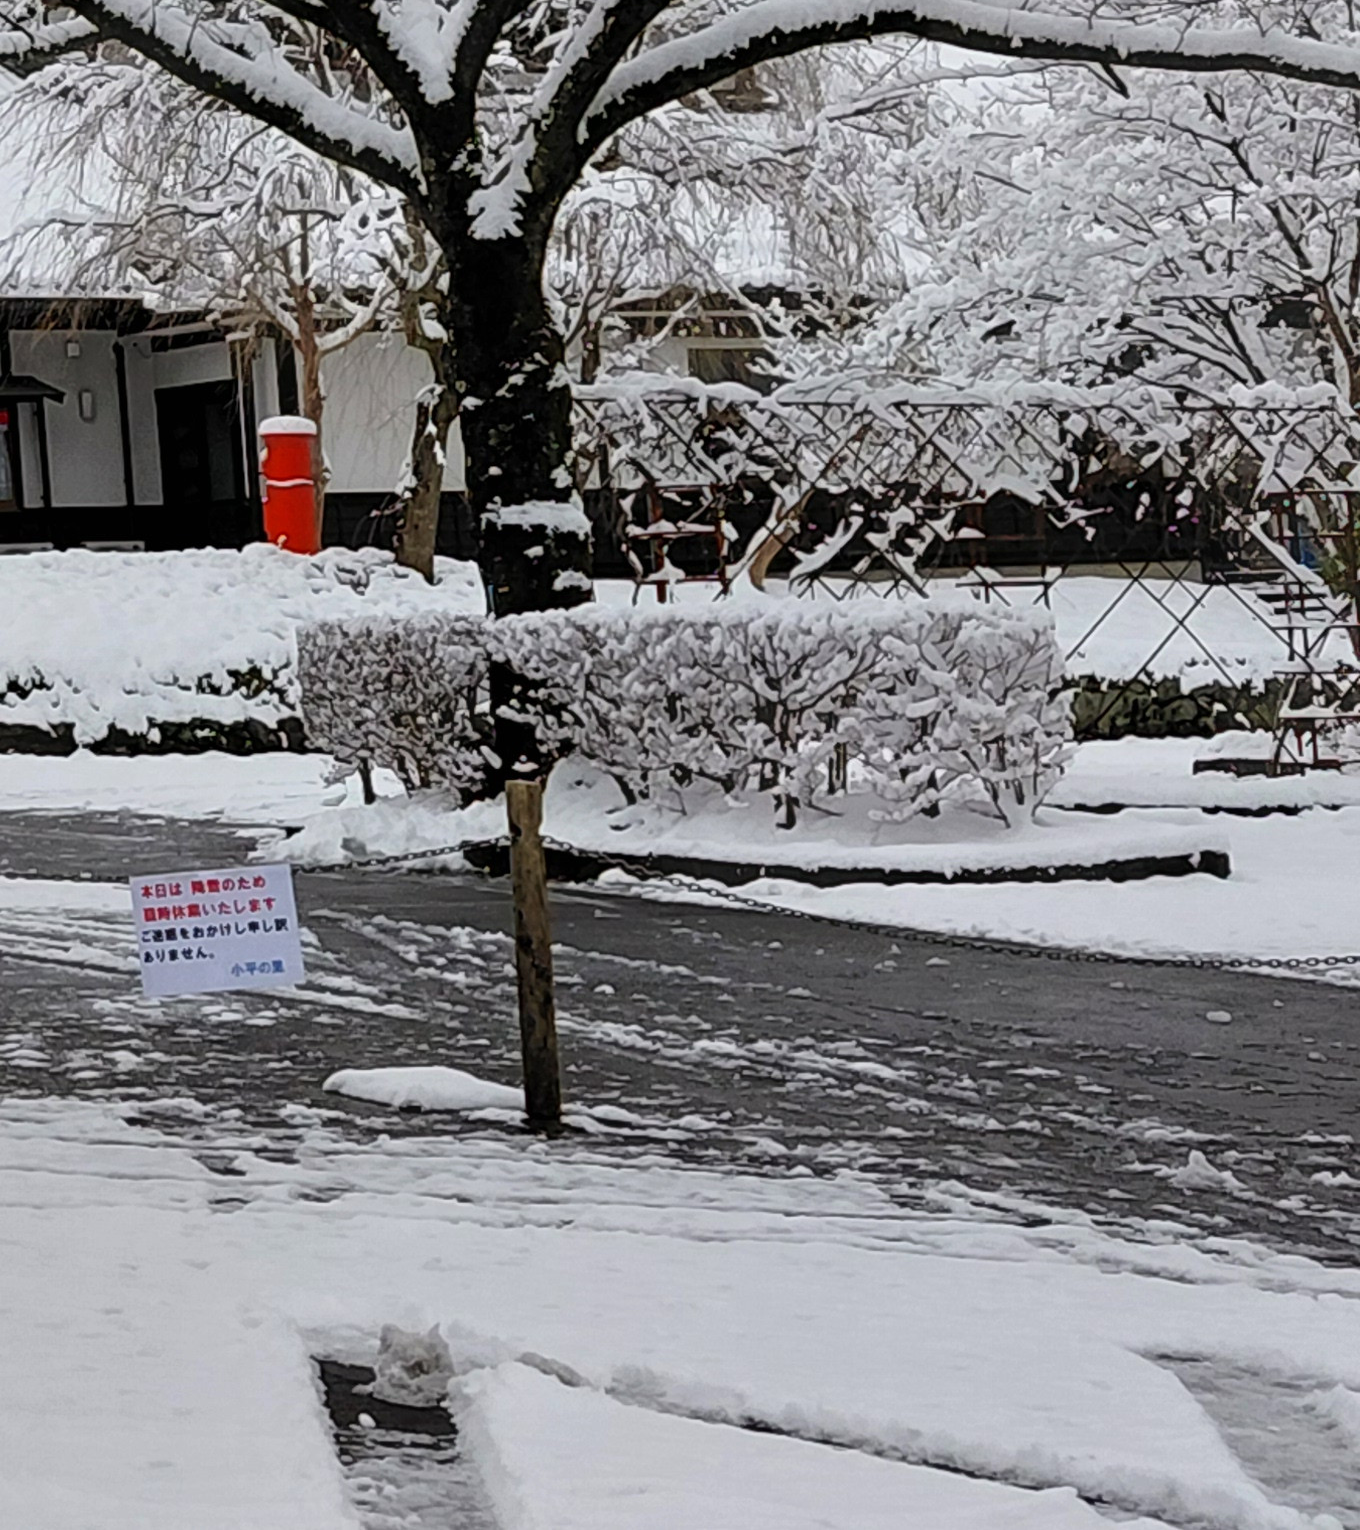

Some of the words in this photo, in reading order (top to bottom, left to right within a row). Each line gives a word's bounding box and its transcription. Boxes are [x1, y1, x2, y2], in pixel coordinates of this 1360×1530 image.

[141, 883, 182, 898] 本日は
[143, 898, 276, 922] 臨時休業いたします
[141, 919, 288, 942] ご迷惑をおかけし申し訳
[144, 947, 215, 963] ありません。
[231, 960, 285, 976] 小平の里
